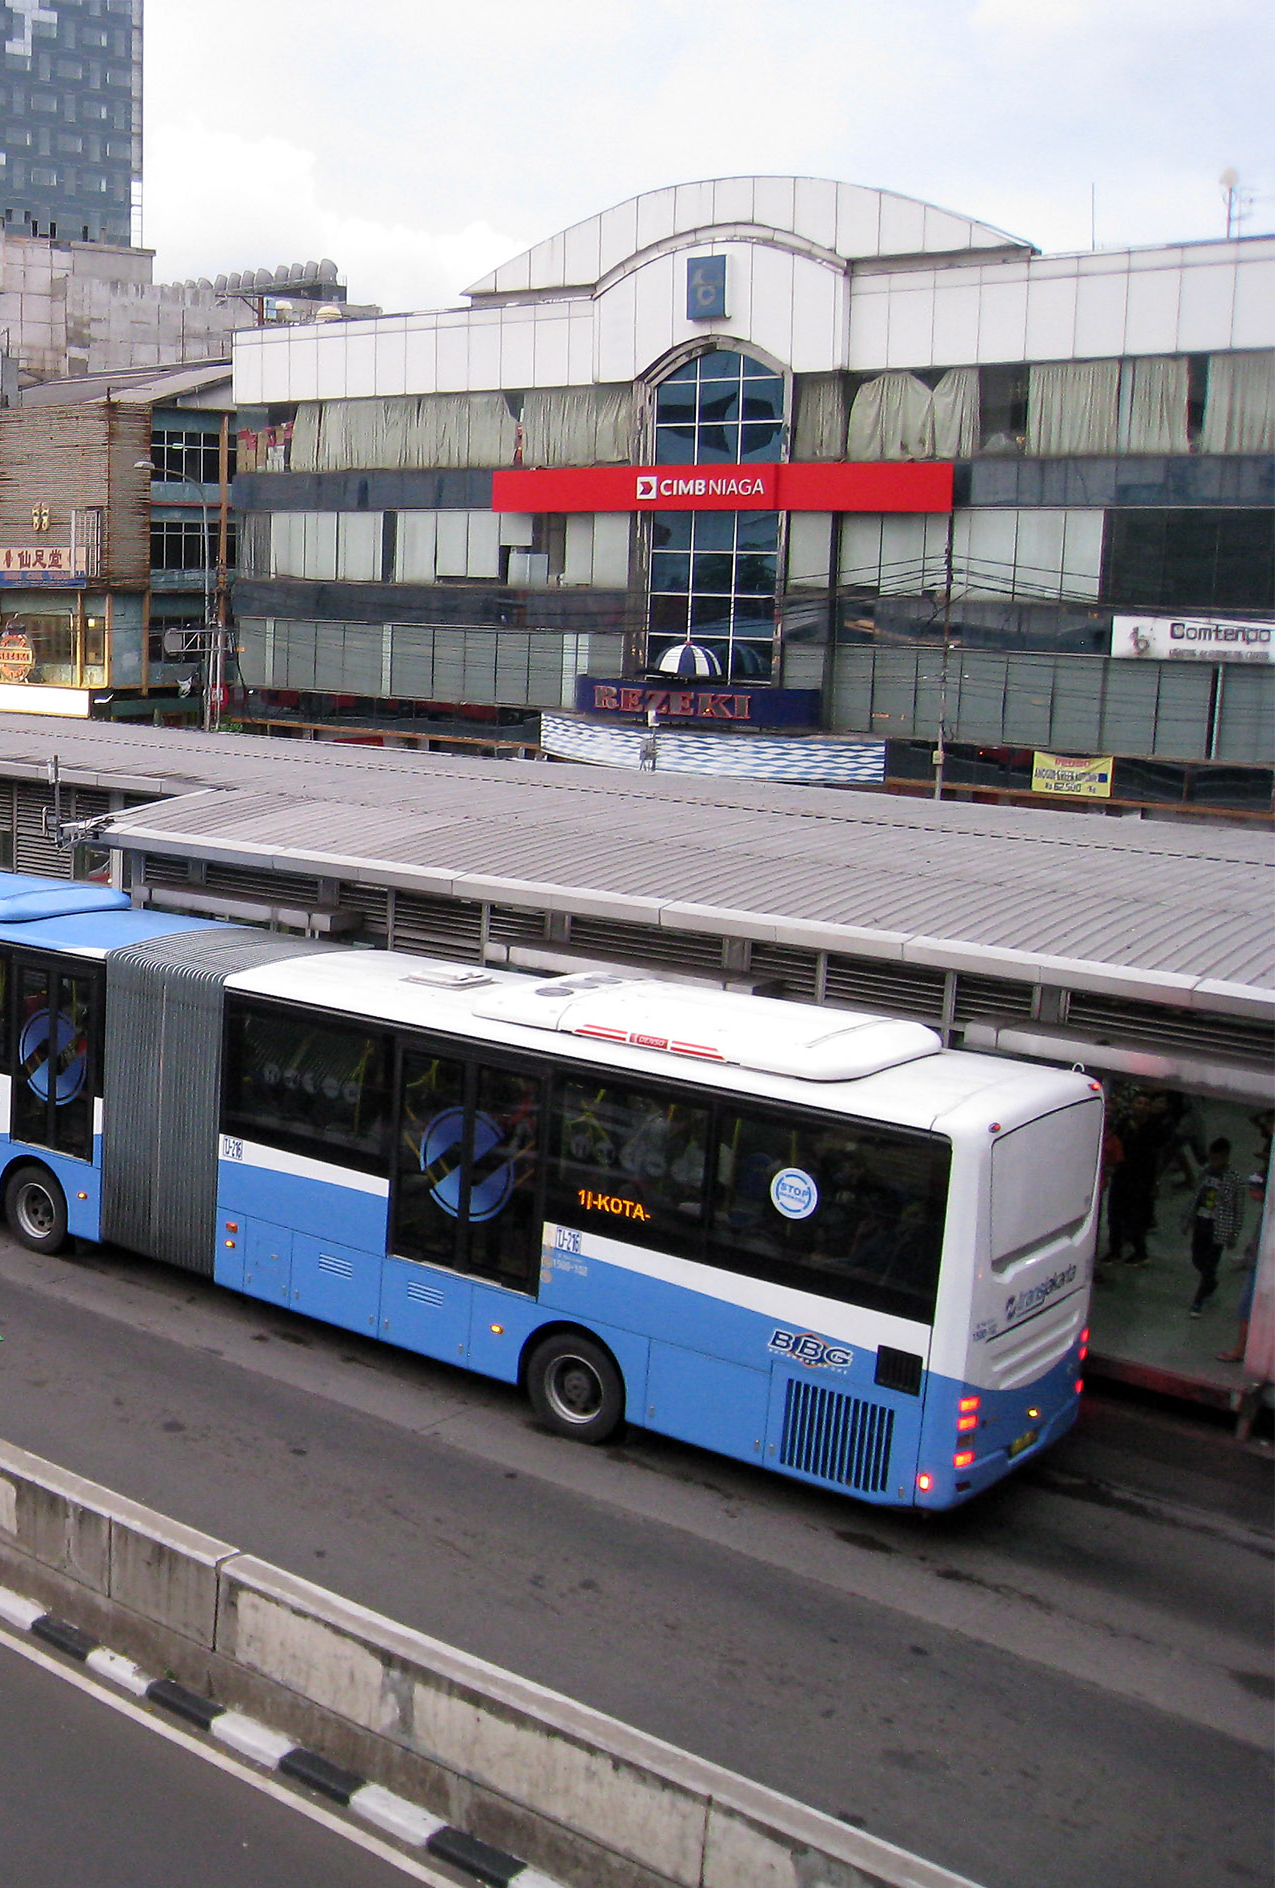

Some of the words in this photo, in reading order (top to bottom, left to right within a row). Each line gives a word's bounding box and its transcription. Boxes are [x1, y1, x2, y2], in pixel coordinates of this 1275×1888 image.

[18, 549, 62, 569] 仙足堂
[593, 685, 751, 720] REZEKI
[638, 1036, 664, 1047] DENSO
[781, 1182, 810, 1197] STOP
[768, 1329, 853, 1367] BBG
